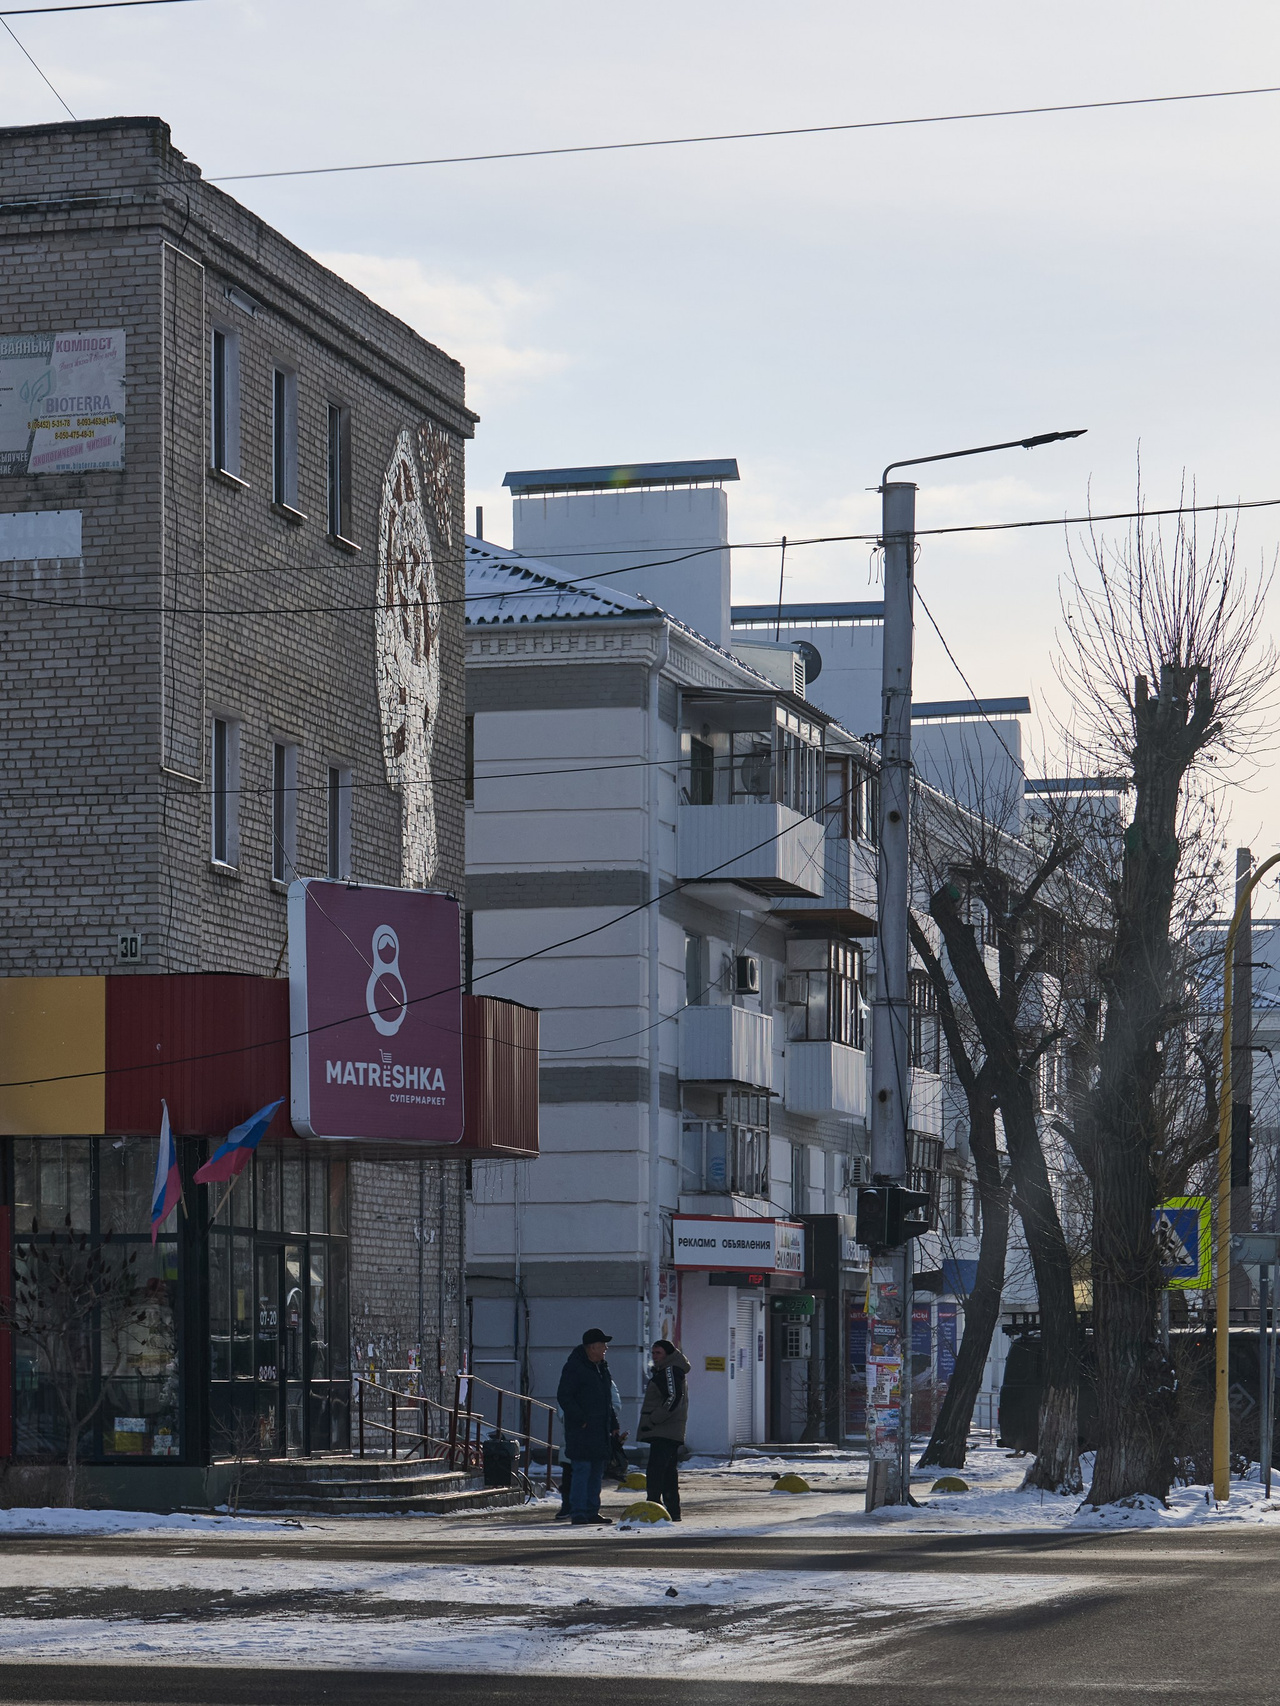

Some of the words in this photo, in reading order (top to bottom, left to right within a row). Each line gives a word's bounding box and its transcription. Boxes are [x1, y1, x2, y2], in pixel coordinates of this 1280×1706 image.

[56, 337, 112, 352] КОМПОСТ
[46, 395, 111, 413] BIOTERRA
[51, 419, 70, 428] 5-31-78
[33, 443, 83, 467] ЭКОЛОГИЧЕСКИ
[56, 461, 119, 471] www.bioterra.com.ua
[121, 937, 138, 958] 30
[390, 1094, 446, 1106] СУПЕРМАРКЕТ
[748, 1274, 763, 1285] ПЕР
